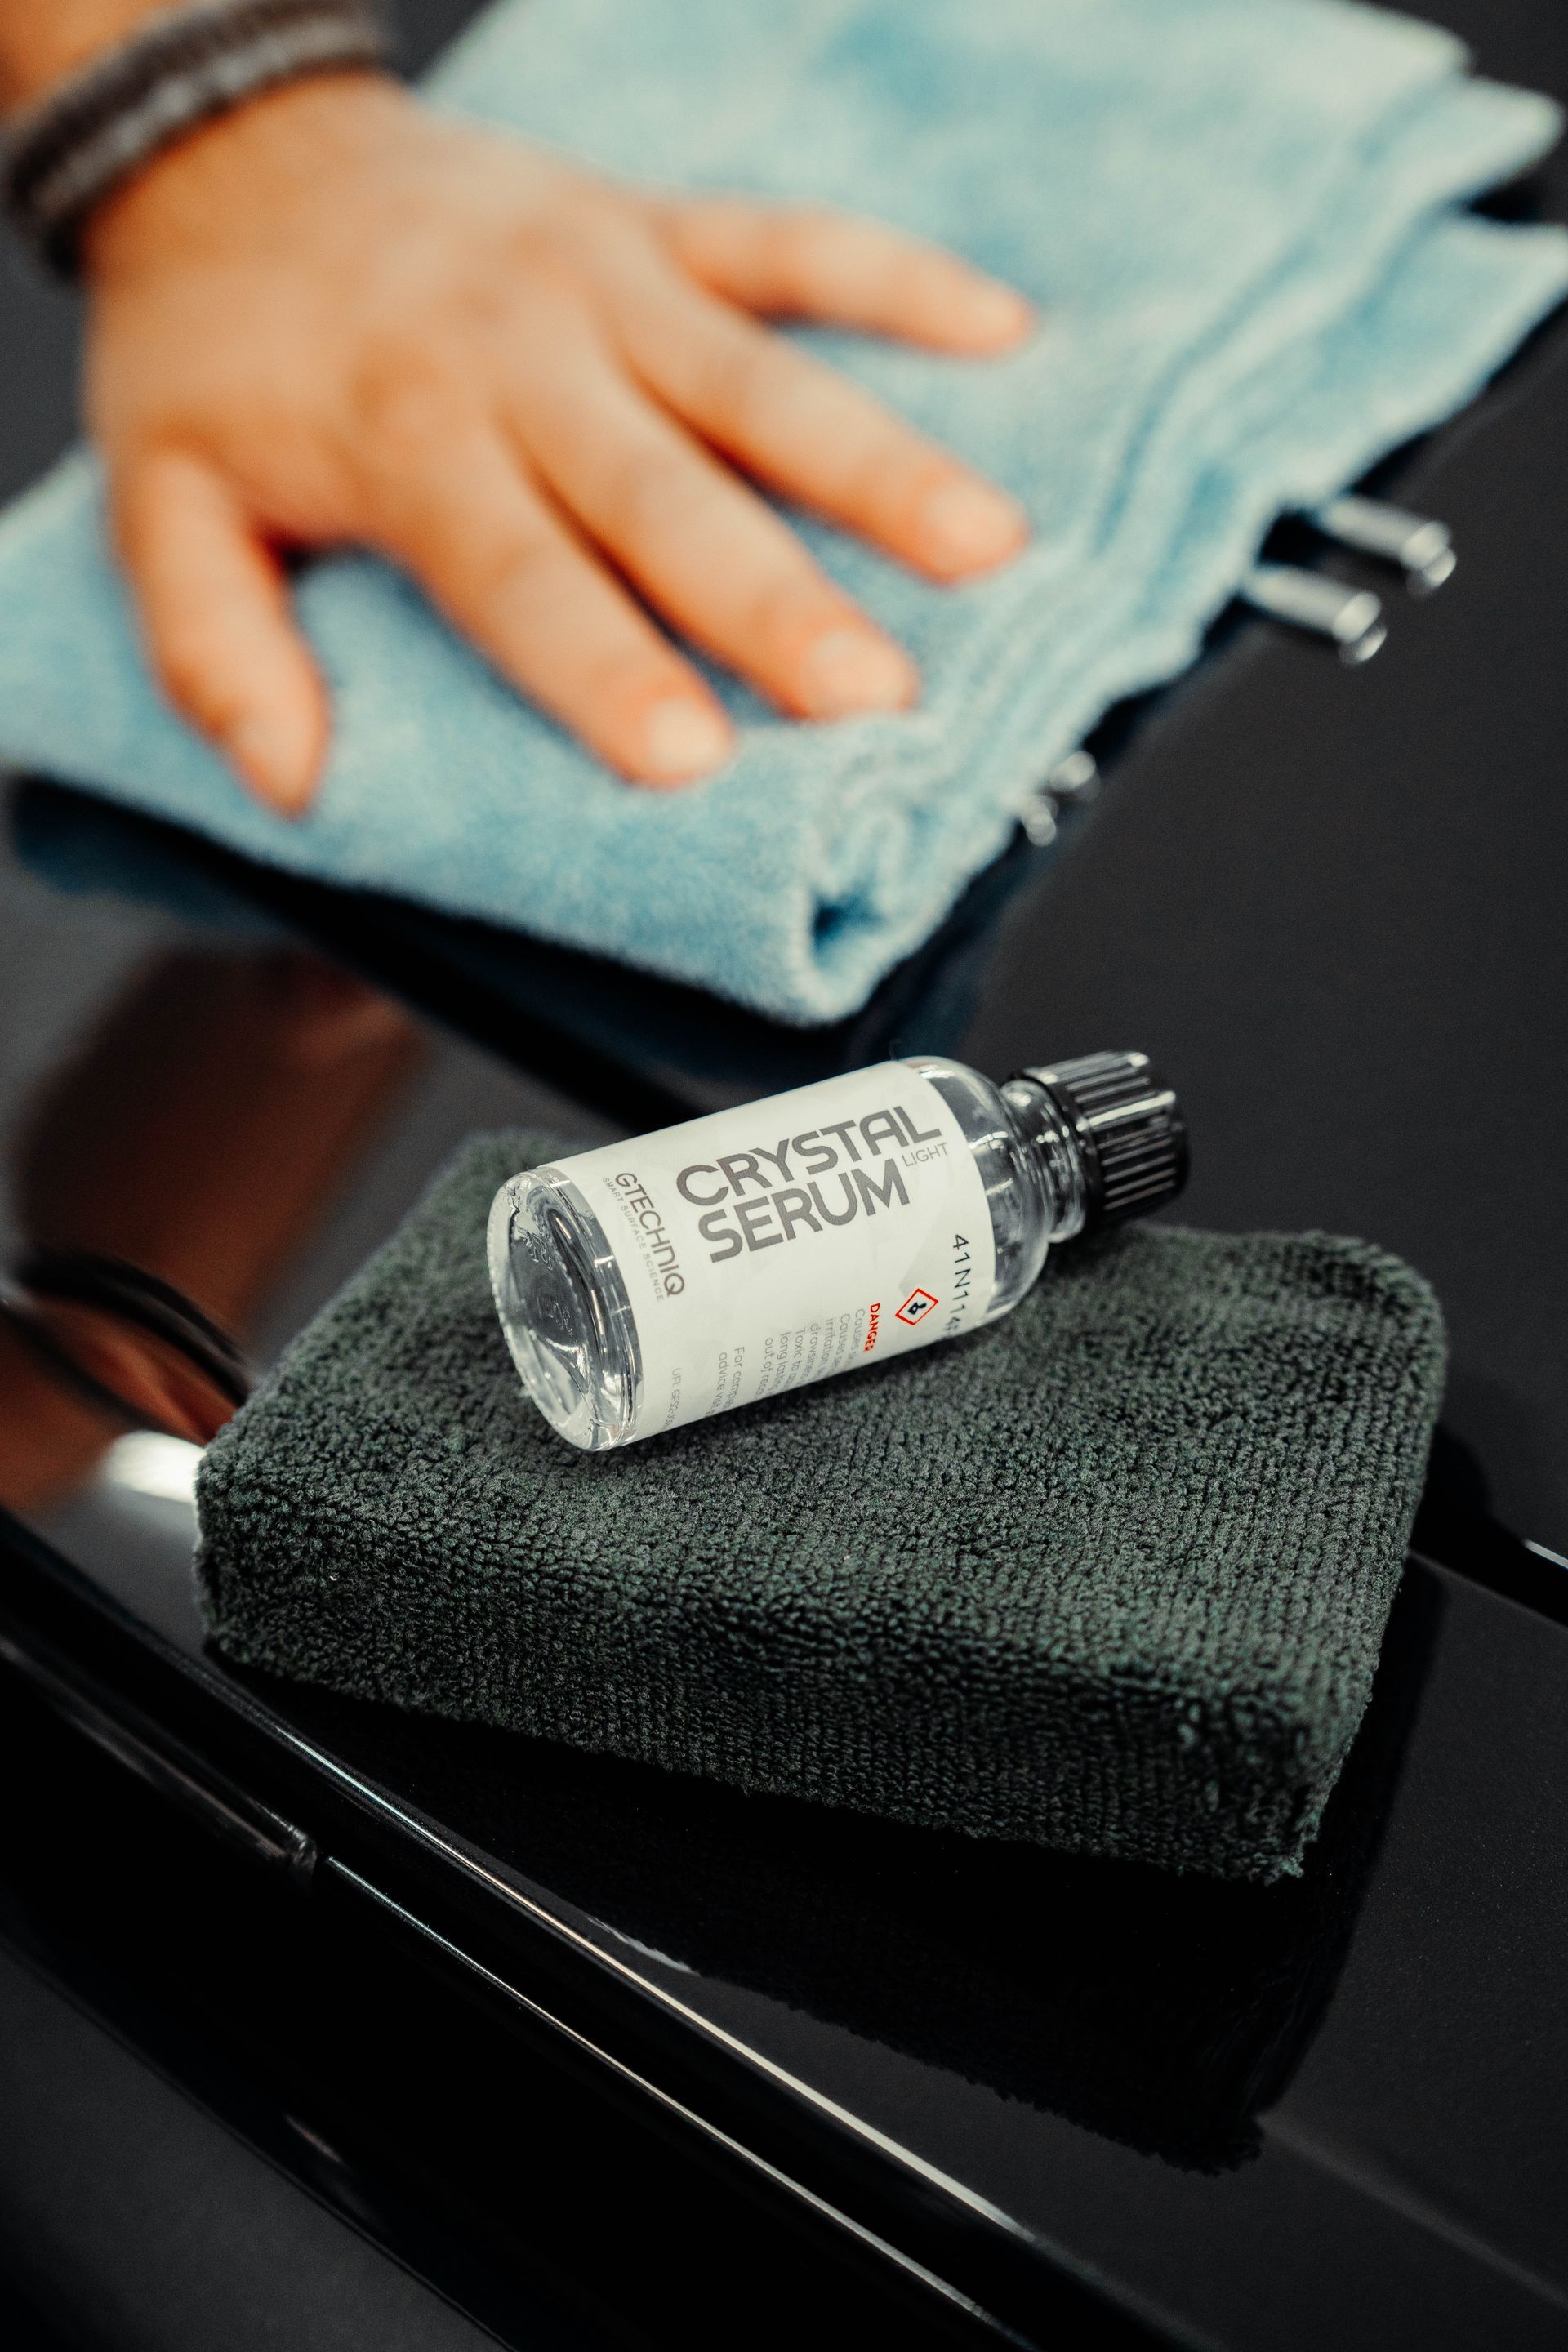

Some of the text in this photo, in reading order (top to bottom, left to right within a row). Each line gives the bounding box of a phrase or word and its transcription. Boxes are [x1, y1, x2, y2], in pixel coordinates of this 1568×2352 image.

[676, 1106, 942, 1206] CRYSTAL
[902, 1143, 948, 1167] LIGHT
[698, 1158, 911, 1263] SERUM
[603, 1177, 665, 1302] SMART SURFACE SCIENCE
[615, 1173, 684, 1298] GTECHNIQ
[764, 1338, 776, 1360] out
[777, 1331, 791, 1360] long
[794, 1327, 805, 1360] Toxic
[836, 1313, 850, 1355] Causes
[718, 1352, 729, 1391] advice
[734, 1346, 745, 1368] For
[761, 1361, 773, 1372] of
